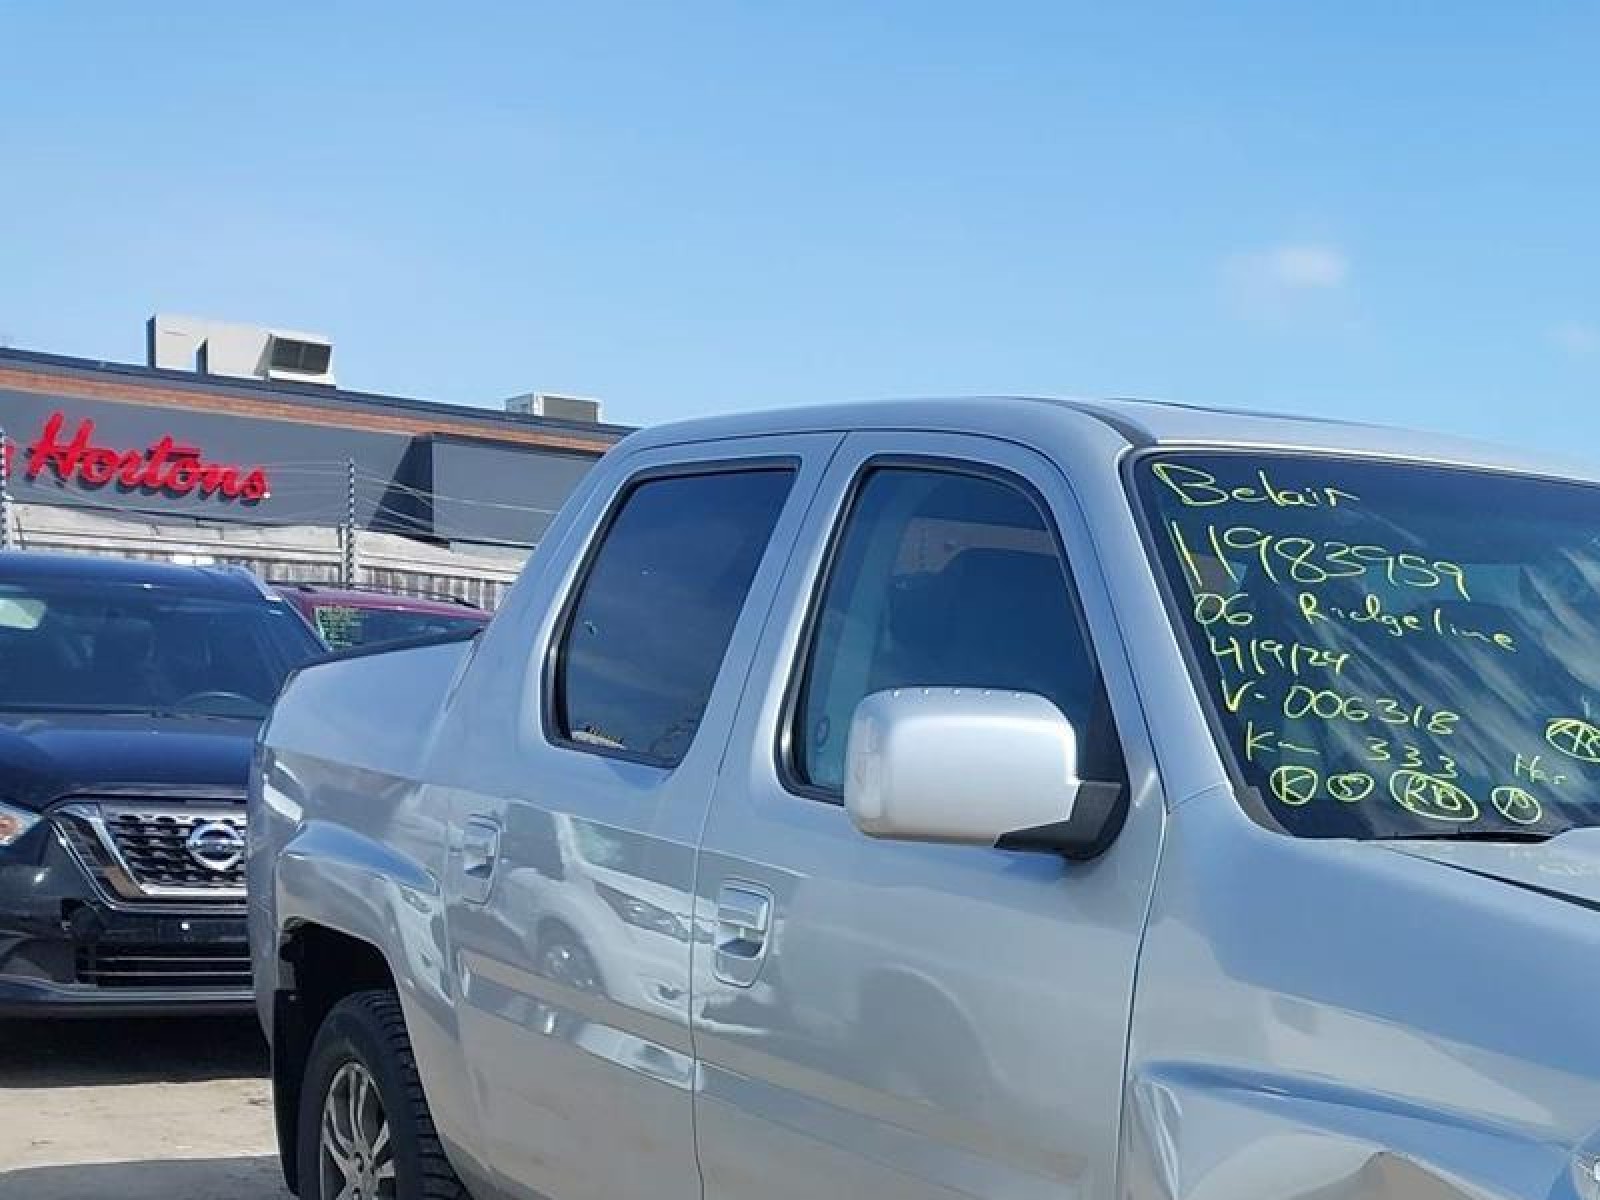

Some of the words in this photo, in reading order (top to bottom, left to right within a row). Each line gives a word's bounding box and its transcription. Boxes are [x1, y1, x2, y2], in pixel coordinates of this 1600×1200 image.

[28, 412, 271, 500] Hortons
[1172, 521, 1471, 601] 11983959
[1194, 595, 1253, 627] 06
